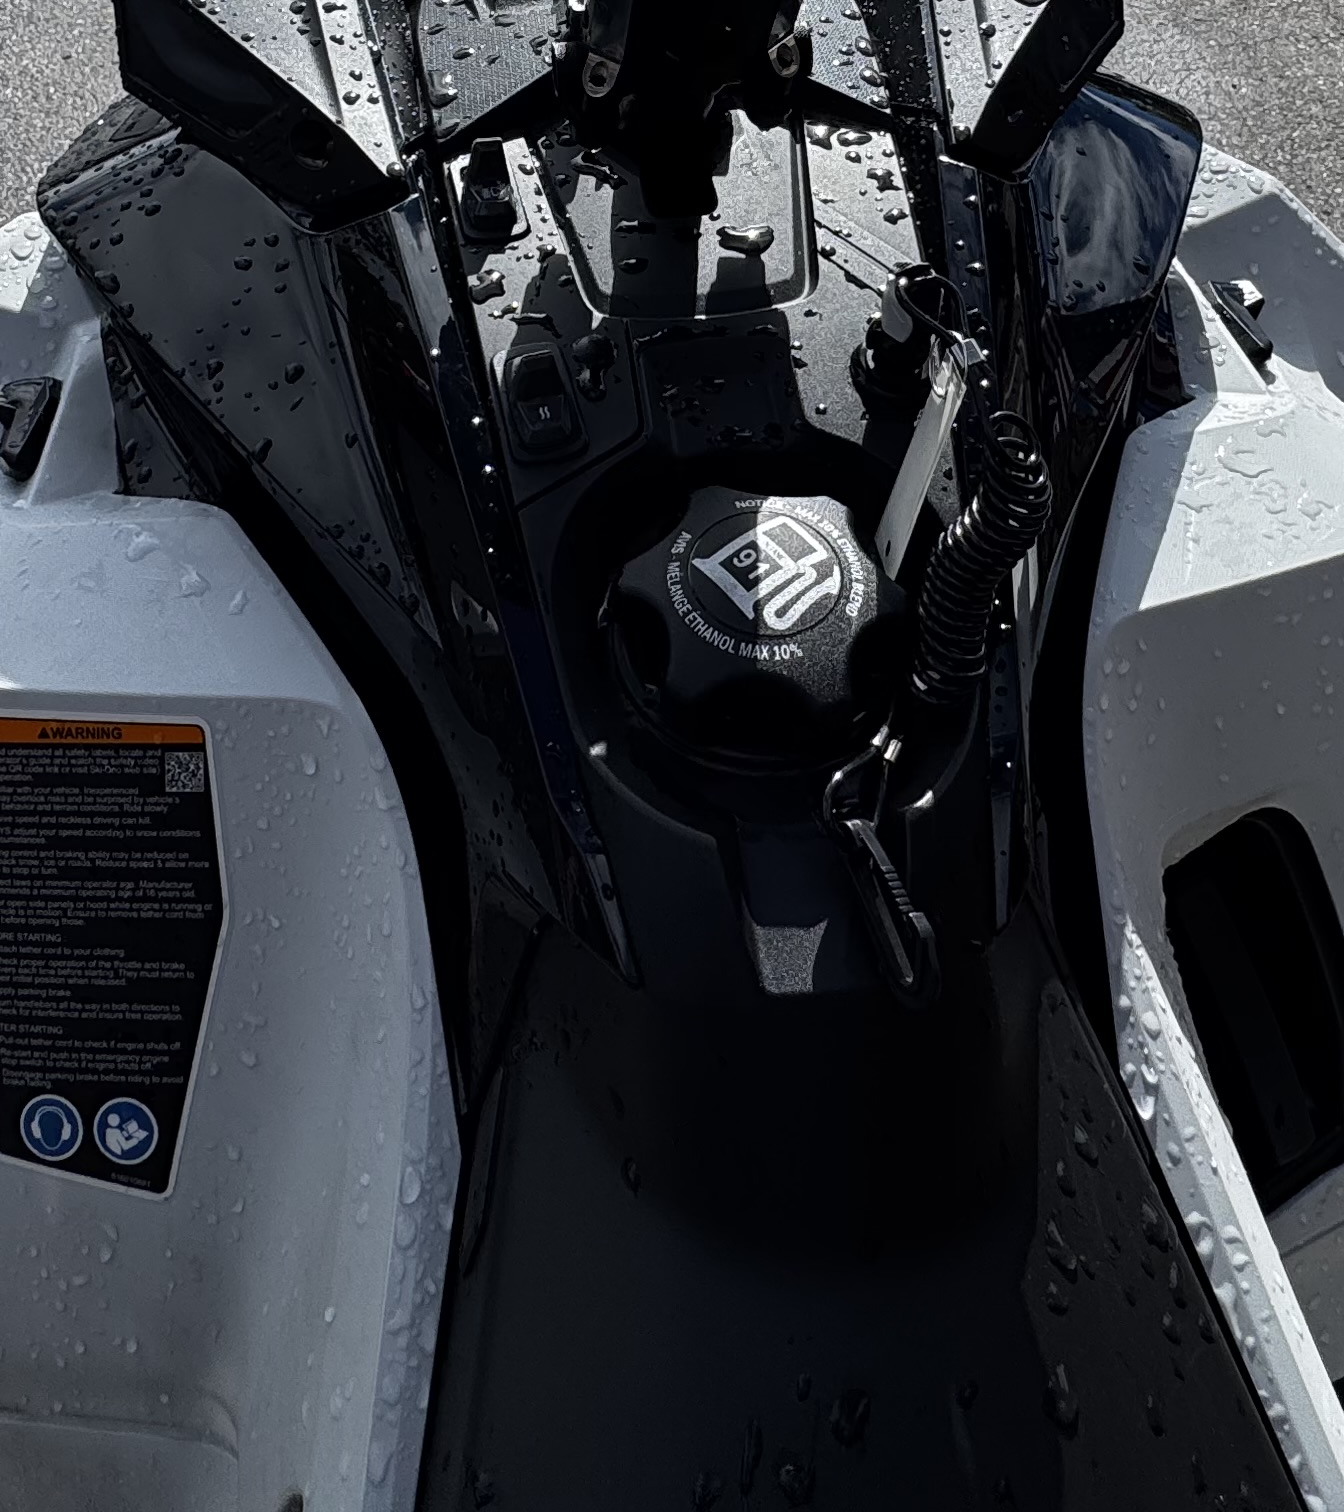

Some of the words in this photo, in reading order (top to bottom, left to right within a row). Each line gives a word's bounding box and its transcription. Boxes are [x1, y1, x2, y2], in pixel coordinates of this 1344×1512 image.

[671, 530, 693, 555] AVIS
[732, 548, 771, 580] 91
[666, 560, 690, 618] MÉLANGE
[684, 610, 736, 655] ÉTHANOL
[738, 642, 770, 661] MAX
[772, 642, 803, 661] 10%
[49, 727, 123, 740] WARNING
